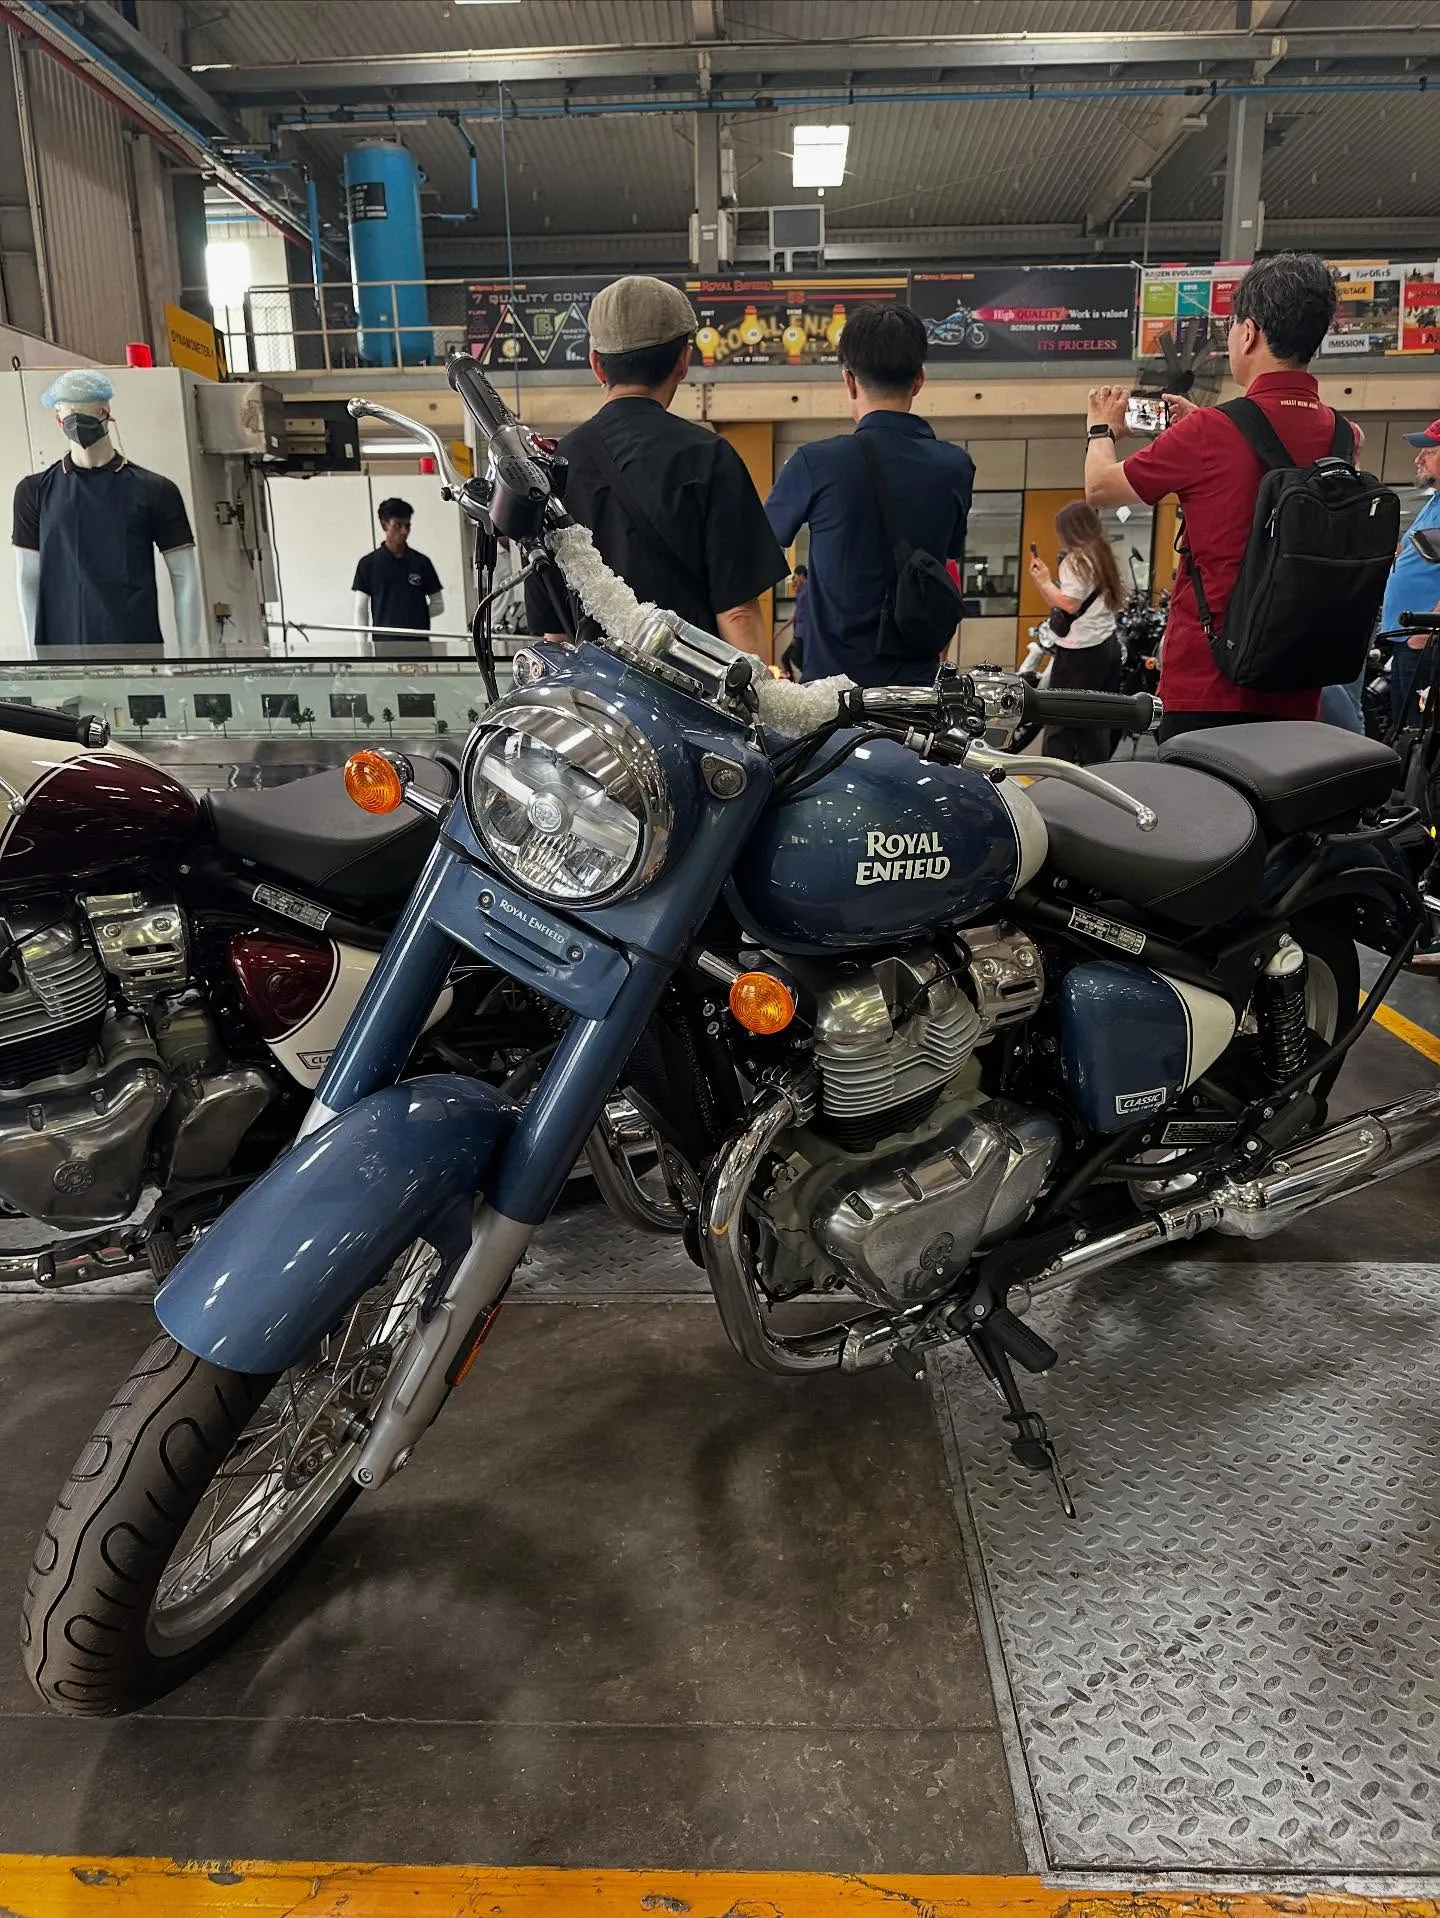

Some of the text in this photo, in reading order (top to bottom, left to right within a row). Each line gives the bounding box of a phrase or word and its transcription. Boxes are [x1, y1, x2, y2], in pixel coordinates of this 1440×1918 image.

[701, 280, 732, 291] ROYAL
[473, 292, 596, 304] 7 QUALITY CONT
[993, 308, 1128, 321] High QUALITY Work is valued
[1036, 323, 1059, 332] every
[1037, 339, 1118, 351] ITS PRICELESS
[866, 831, 944, 859] ROYAL
[855, 856, 951, 886] ENFIELD
[499, 899, 565, 944] ROYAL ENFIELD
[311, 1056, 331, 1064] CLA
[1123, 1093, 1161, 1108] CLASSIC
